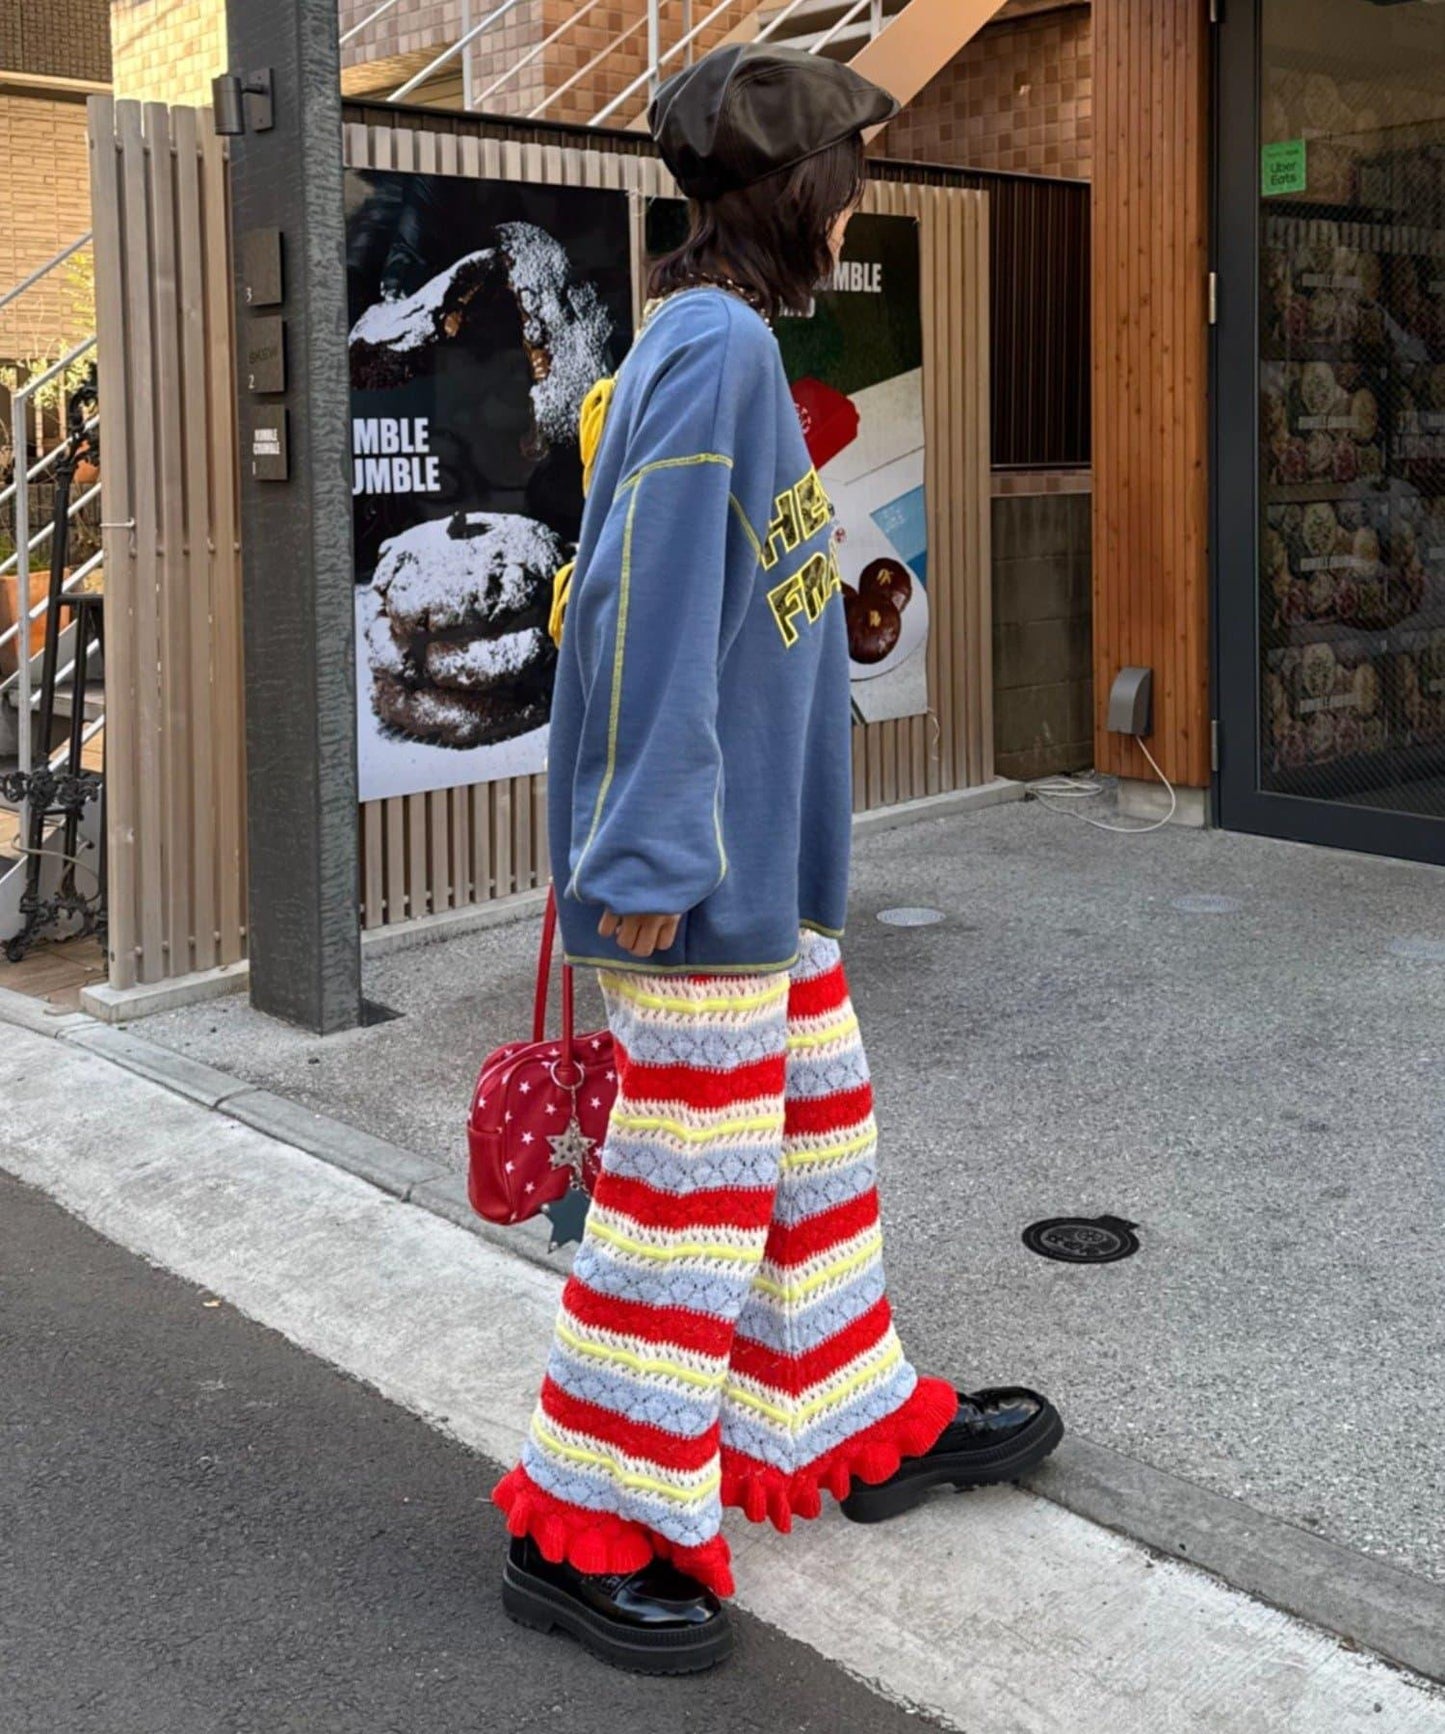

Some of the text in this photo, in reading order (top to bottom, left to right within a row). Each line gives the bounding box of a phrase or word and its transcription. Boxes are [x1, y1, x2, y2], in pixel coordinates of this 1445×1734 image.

[1270, 161, 1296, 173] Uber
[1271, 173, 1297, 185] Eats
[818, 261, 882, 293] MBLE
[246, 287, 253, 302] 3
[248, 373, 255, 389] 2
